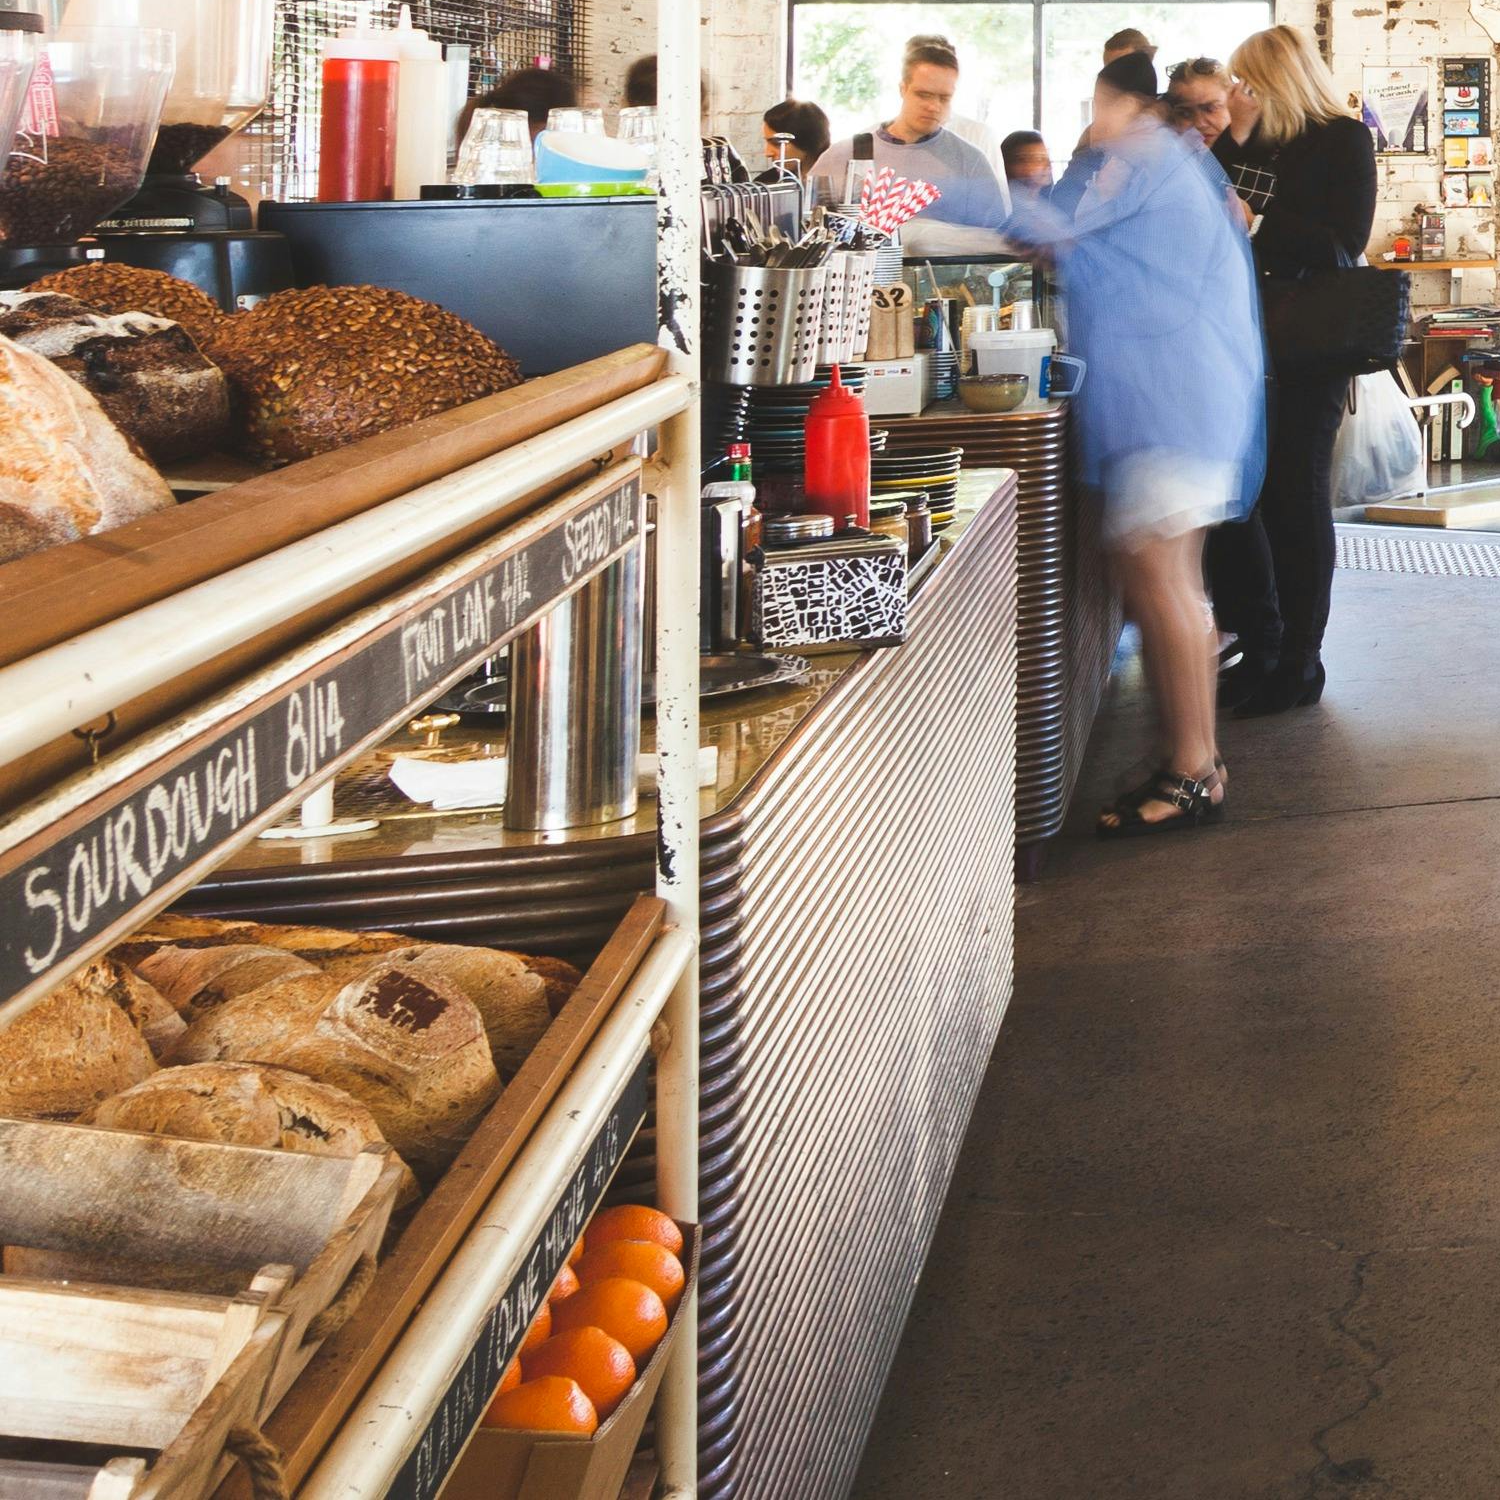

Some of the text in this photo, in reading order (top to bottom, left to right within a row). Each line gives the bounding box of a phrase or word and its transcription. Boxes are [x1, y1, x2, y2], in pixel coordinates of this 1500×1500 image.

[24, 726, 257, 974] SOURDOUGH
[285, 680, 345, 789] 8/14
[402, 607, 447, 705] FRUIT
[452, 573, 496, 656] LOAF
[561, 497, 612, 585] SEEDED
[496, 1243, 541, 1369] OLIVE
[545, 1164, 586, 1281] MICHE
